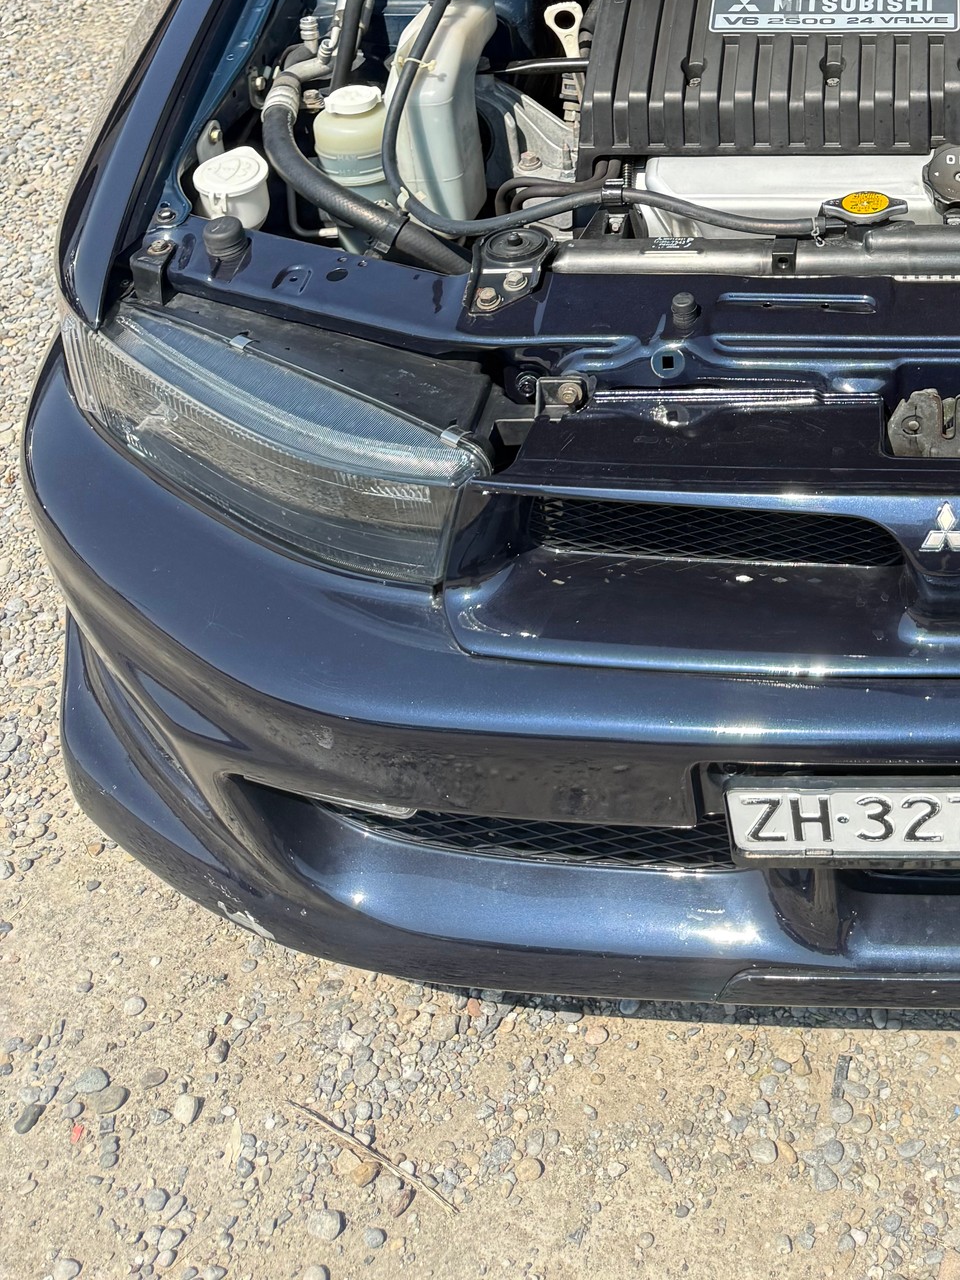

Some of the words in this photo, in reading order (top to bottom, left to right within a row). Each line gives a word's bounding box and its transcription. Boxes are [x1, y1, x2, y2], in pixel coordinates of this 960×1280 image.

[723, 16, 759, 25] V6
[767, 16, 836, 25] 2500
[846, 16, 875, 24] 24
[879, 16, 949, 24] VALVE
